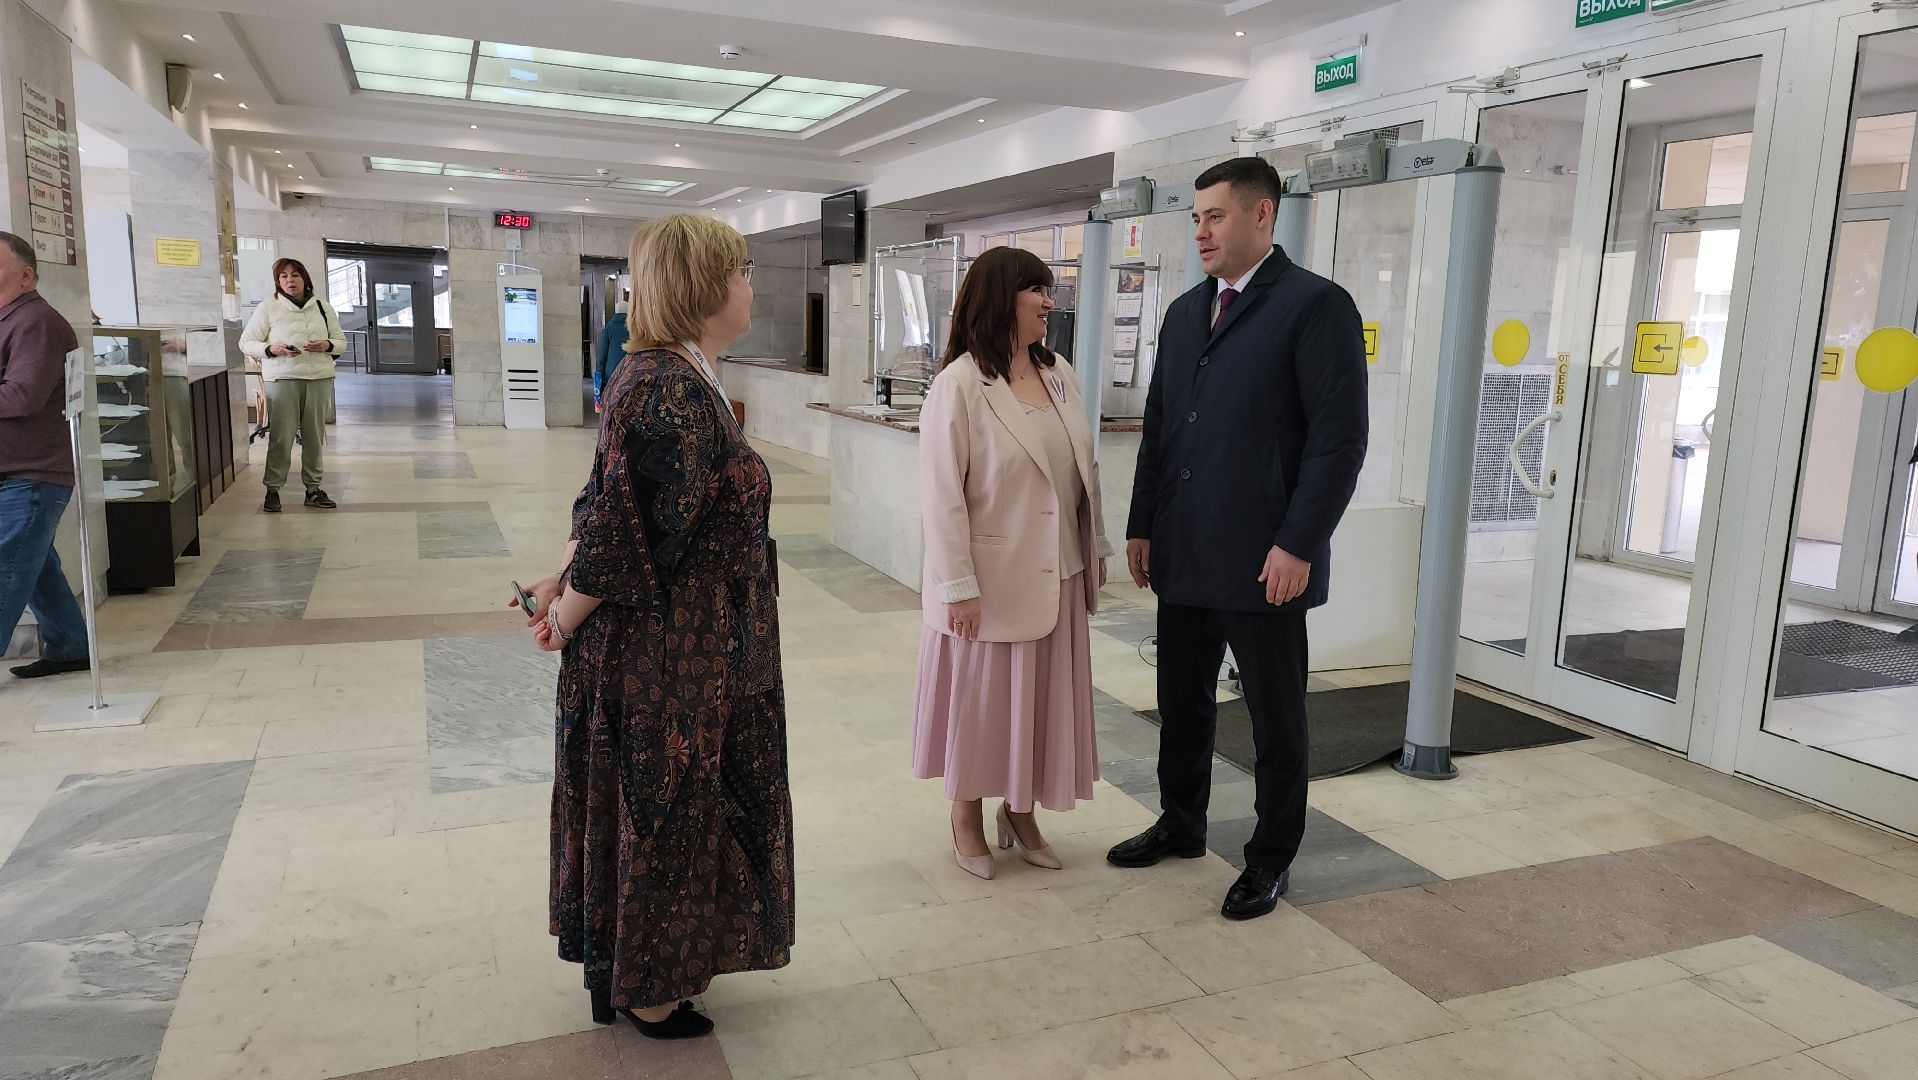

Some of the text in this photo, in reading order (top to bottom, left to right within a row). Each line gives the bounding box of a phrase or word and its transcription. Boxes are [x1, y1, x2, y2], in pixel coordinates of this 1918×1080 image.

[1317, 62, 1354, 84] ВЫХОД
[500, 215, 529, 227] 12:30
[1555, 363, 1568, 405] СЕБЯ
